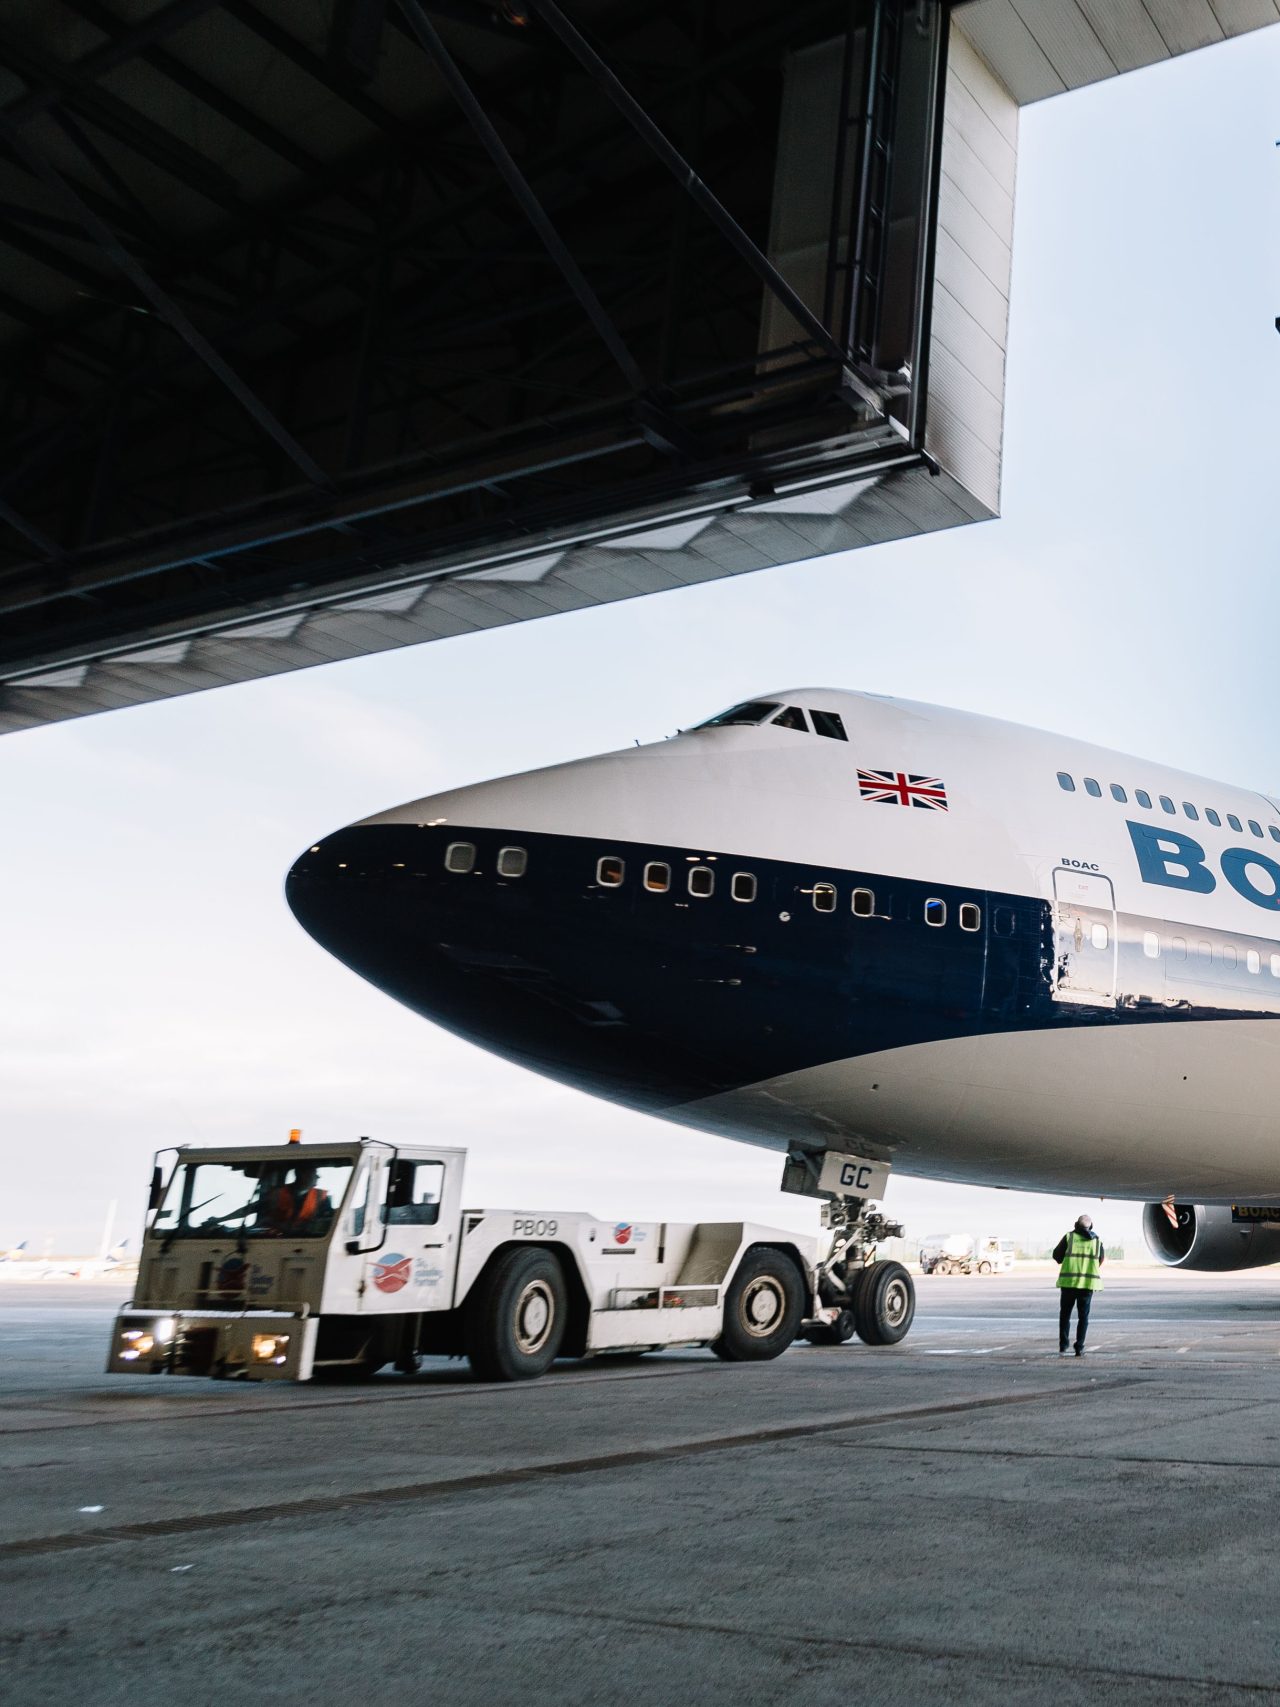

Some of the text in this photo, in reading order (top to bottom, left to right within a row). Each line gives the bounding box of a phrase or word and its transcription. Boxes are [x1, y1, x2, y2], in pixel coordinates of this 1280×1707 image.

[1061, 857, 1100, 871] BOAC
[840, 1163, 873, 1189] GC
[512, 1220, 558, 1236] PB09
